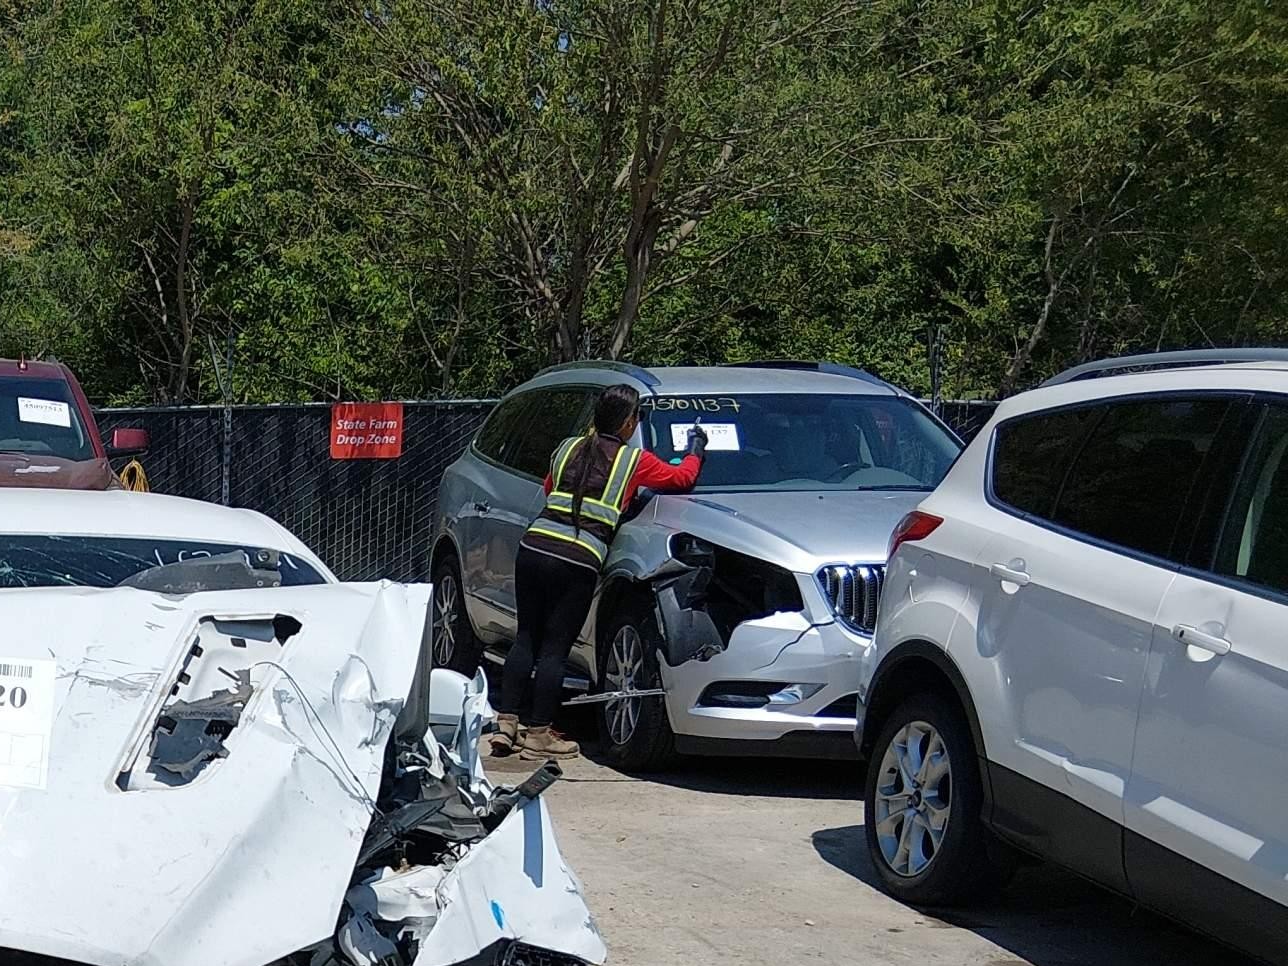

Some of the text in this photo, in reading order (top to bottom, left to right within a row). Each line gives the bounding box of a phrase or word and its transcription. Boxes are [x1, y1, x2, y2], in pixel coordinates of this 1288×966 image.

[335, 419, 397, 430] State Farm
[336, 434, 396, 447] Drop Zone
